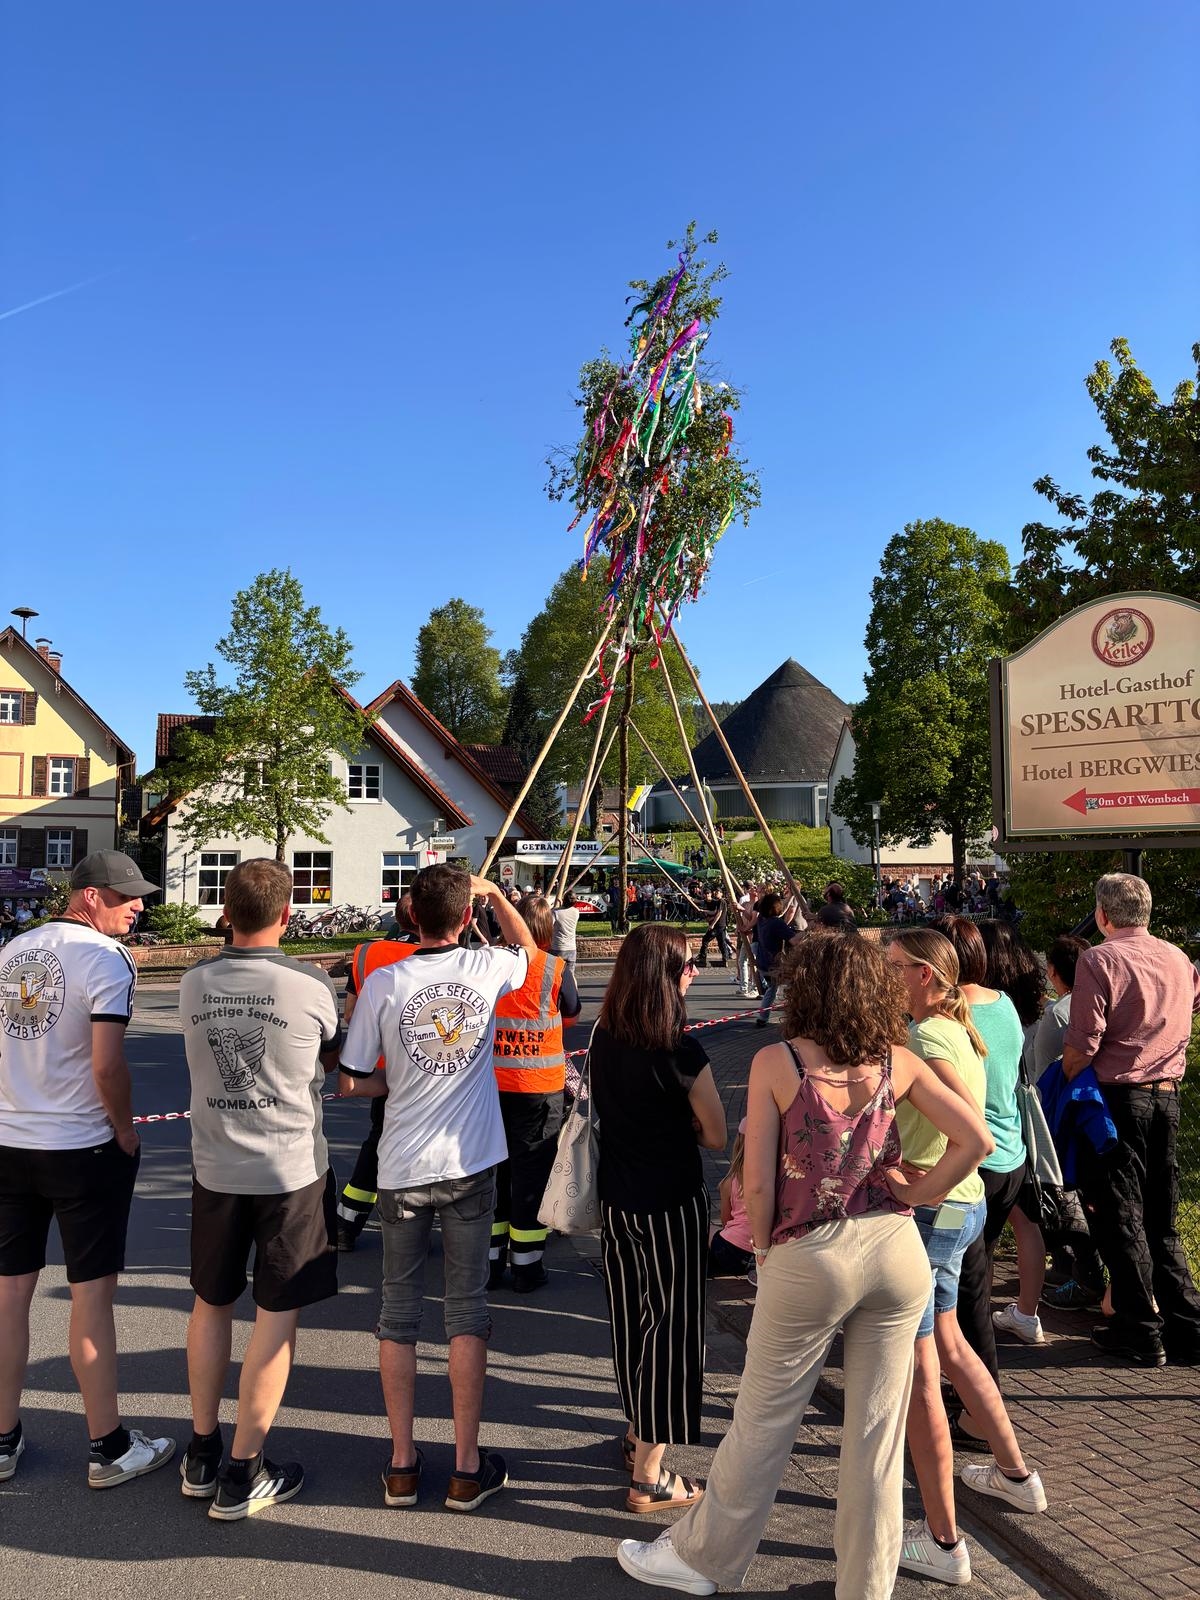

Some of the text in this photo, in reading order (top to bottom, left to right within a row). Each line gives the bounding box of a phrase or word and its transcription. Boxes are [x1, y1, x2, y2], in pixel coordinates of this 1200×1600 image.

[1102, 641, 1145, 659] Keiler
[1059, 669, 1195, 700] Hotel-Gasthof
[1022, 761, 1073, 781] Hotel
[1117, 795, 1135, 805] OT
[1136, 793, 1190, 804] Wombach
[0, 950, 64, 986] DURSTIGE SEELEN
[202, 994, 275, 1006] Stammtisch
[401, 985, 487, 1026] DURSTIGE SEELEN
[191, 1006, 289, 1029] Durstige Seelen
[405, 1030, 436, 1043] Stamm
[496, 1030, 544, 1042] RWEHR
[412, 1036, 485, 1074] WOMBACH
[493, 1044, 540, 1056] MBACH
[206, 1097, 278, 1109] WOMBACH
